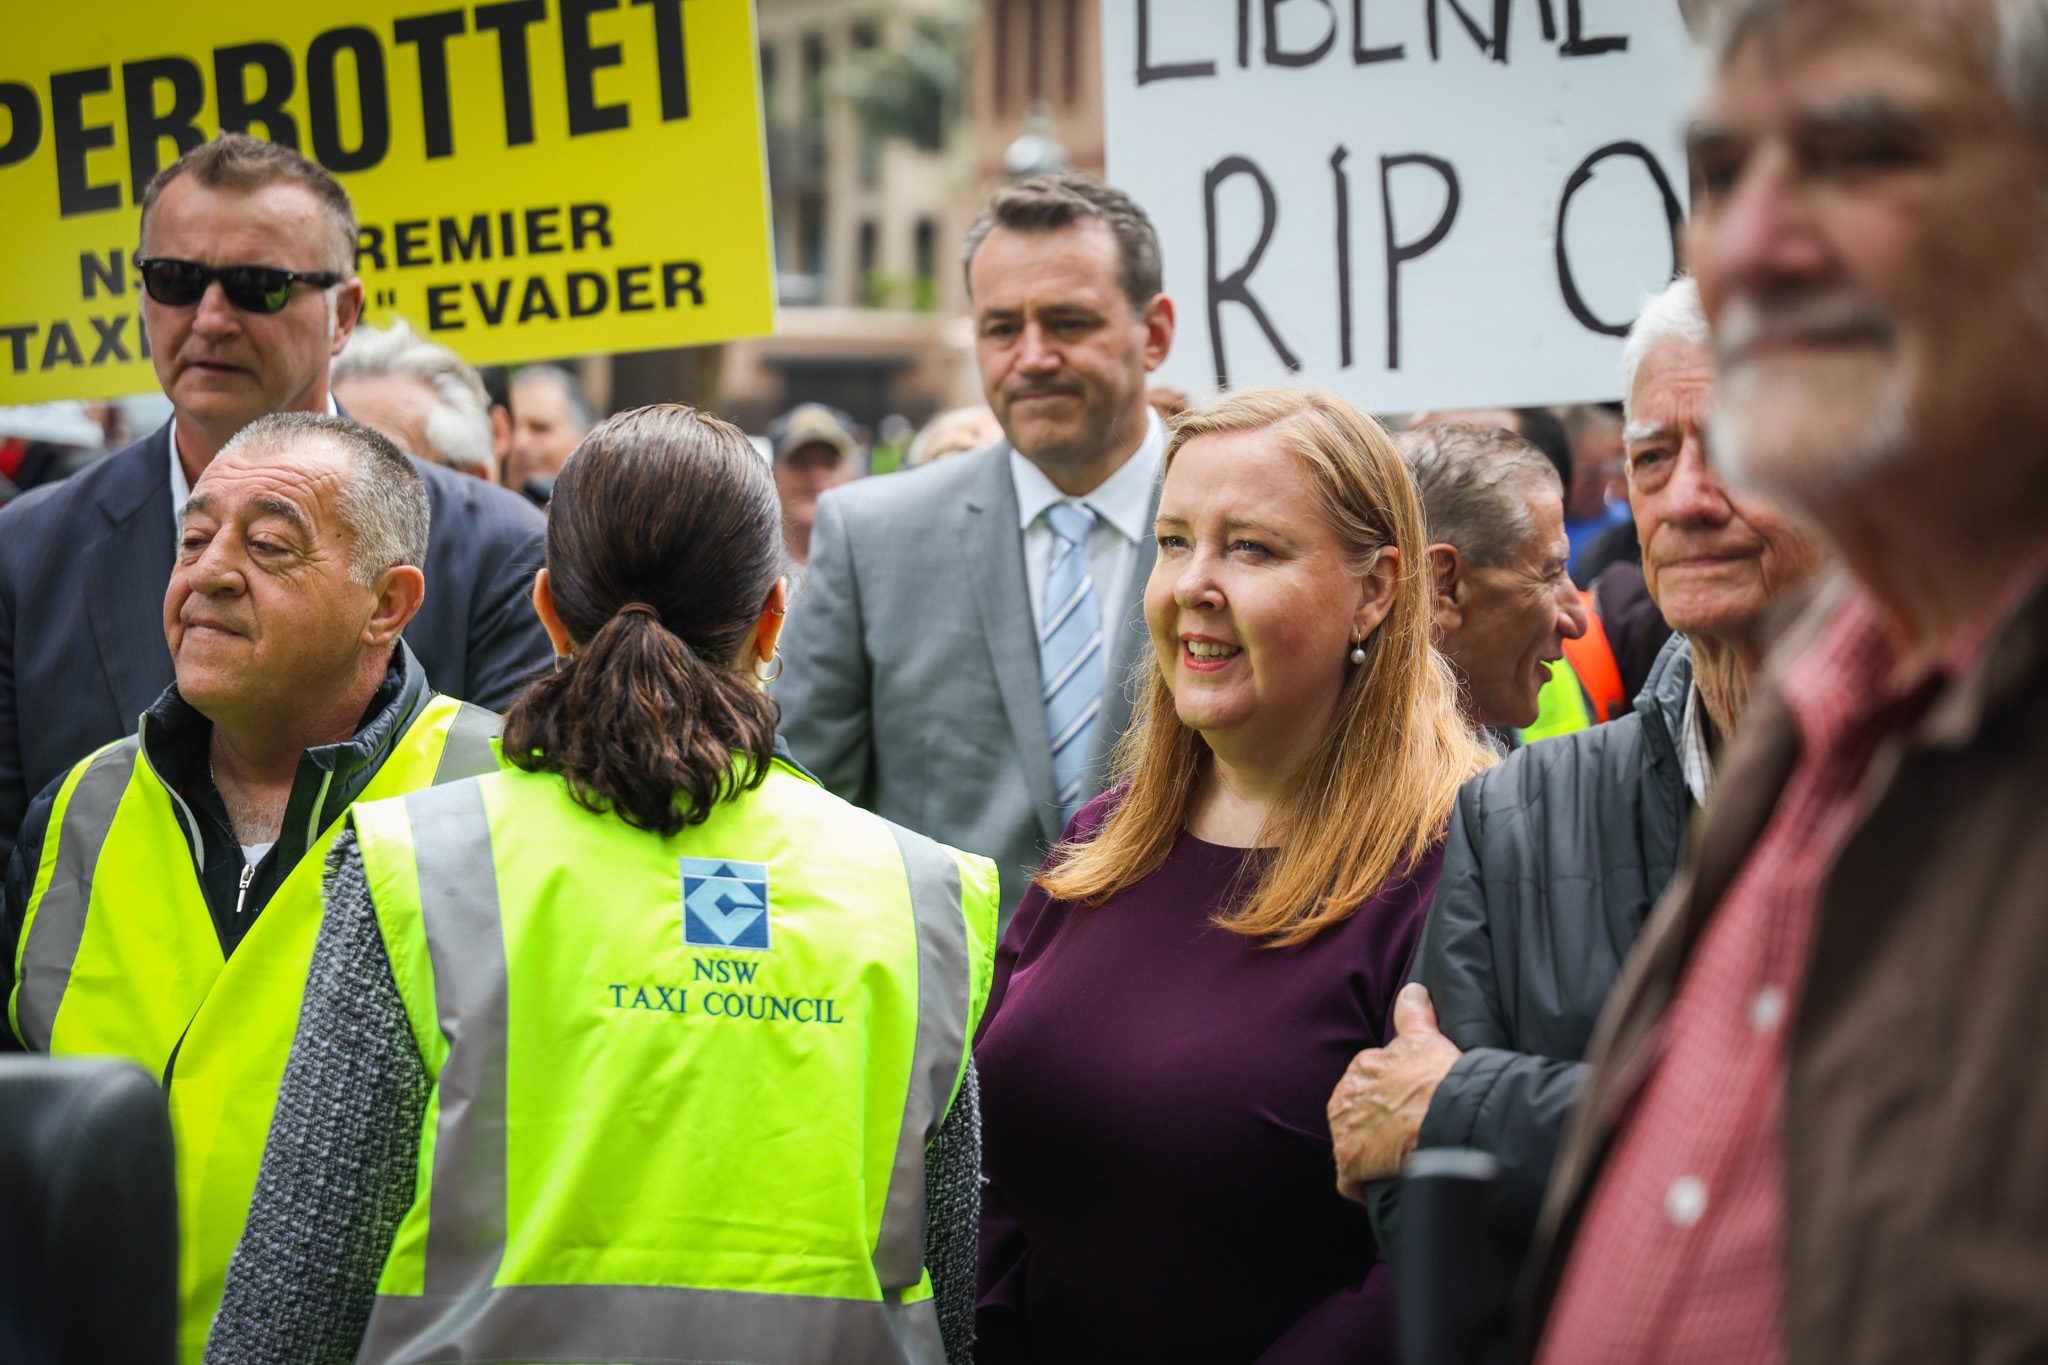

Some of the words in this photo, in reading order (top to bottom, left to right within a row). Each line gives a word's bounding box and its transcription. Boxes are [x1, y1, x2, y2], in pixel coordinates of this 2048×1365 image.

[1204, 143, 1462, 391] RIP
[426, 261, 705, 331] EVADER
[692, 958, 759, 985] NSW
[609, 984, 688, 1013] TAXI
[703, 991, 844, 1023] COUNCIL
